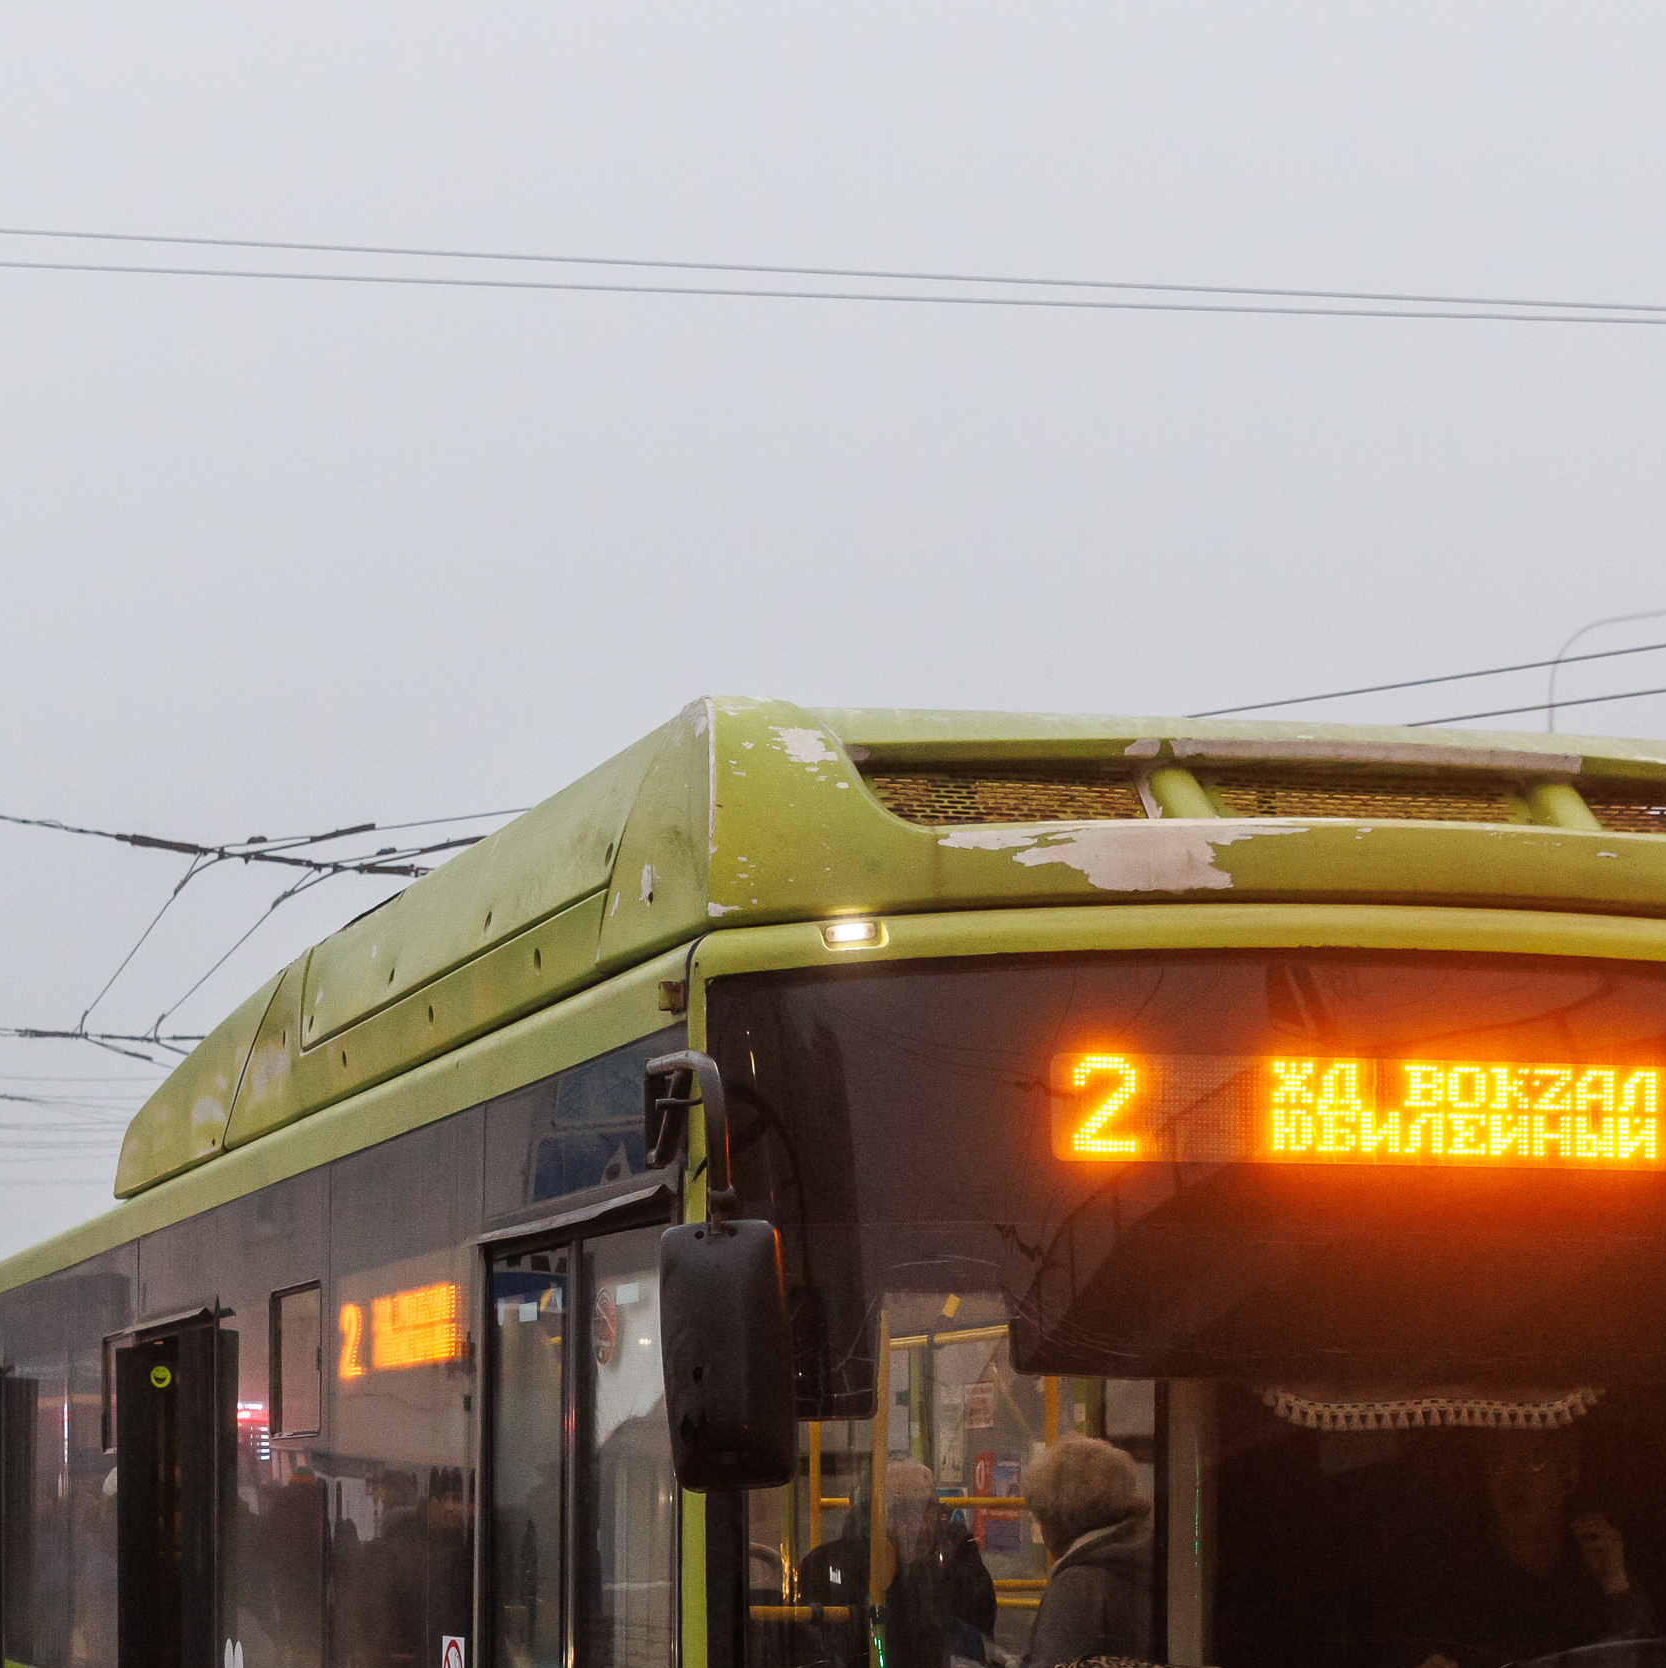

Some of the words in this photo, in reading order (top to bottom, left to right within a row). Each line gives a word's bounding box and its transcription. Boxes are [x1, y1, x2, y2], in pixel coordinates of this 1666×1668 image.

[1073, 1056, 1135, 1153] 2
[1272, 1061, 1361, 1114] ЖД
[340, 1303, 363, 1378] 2
